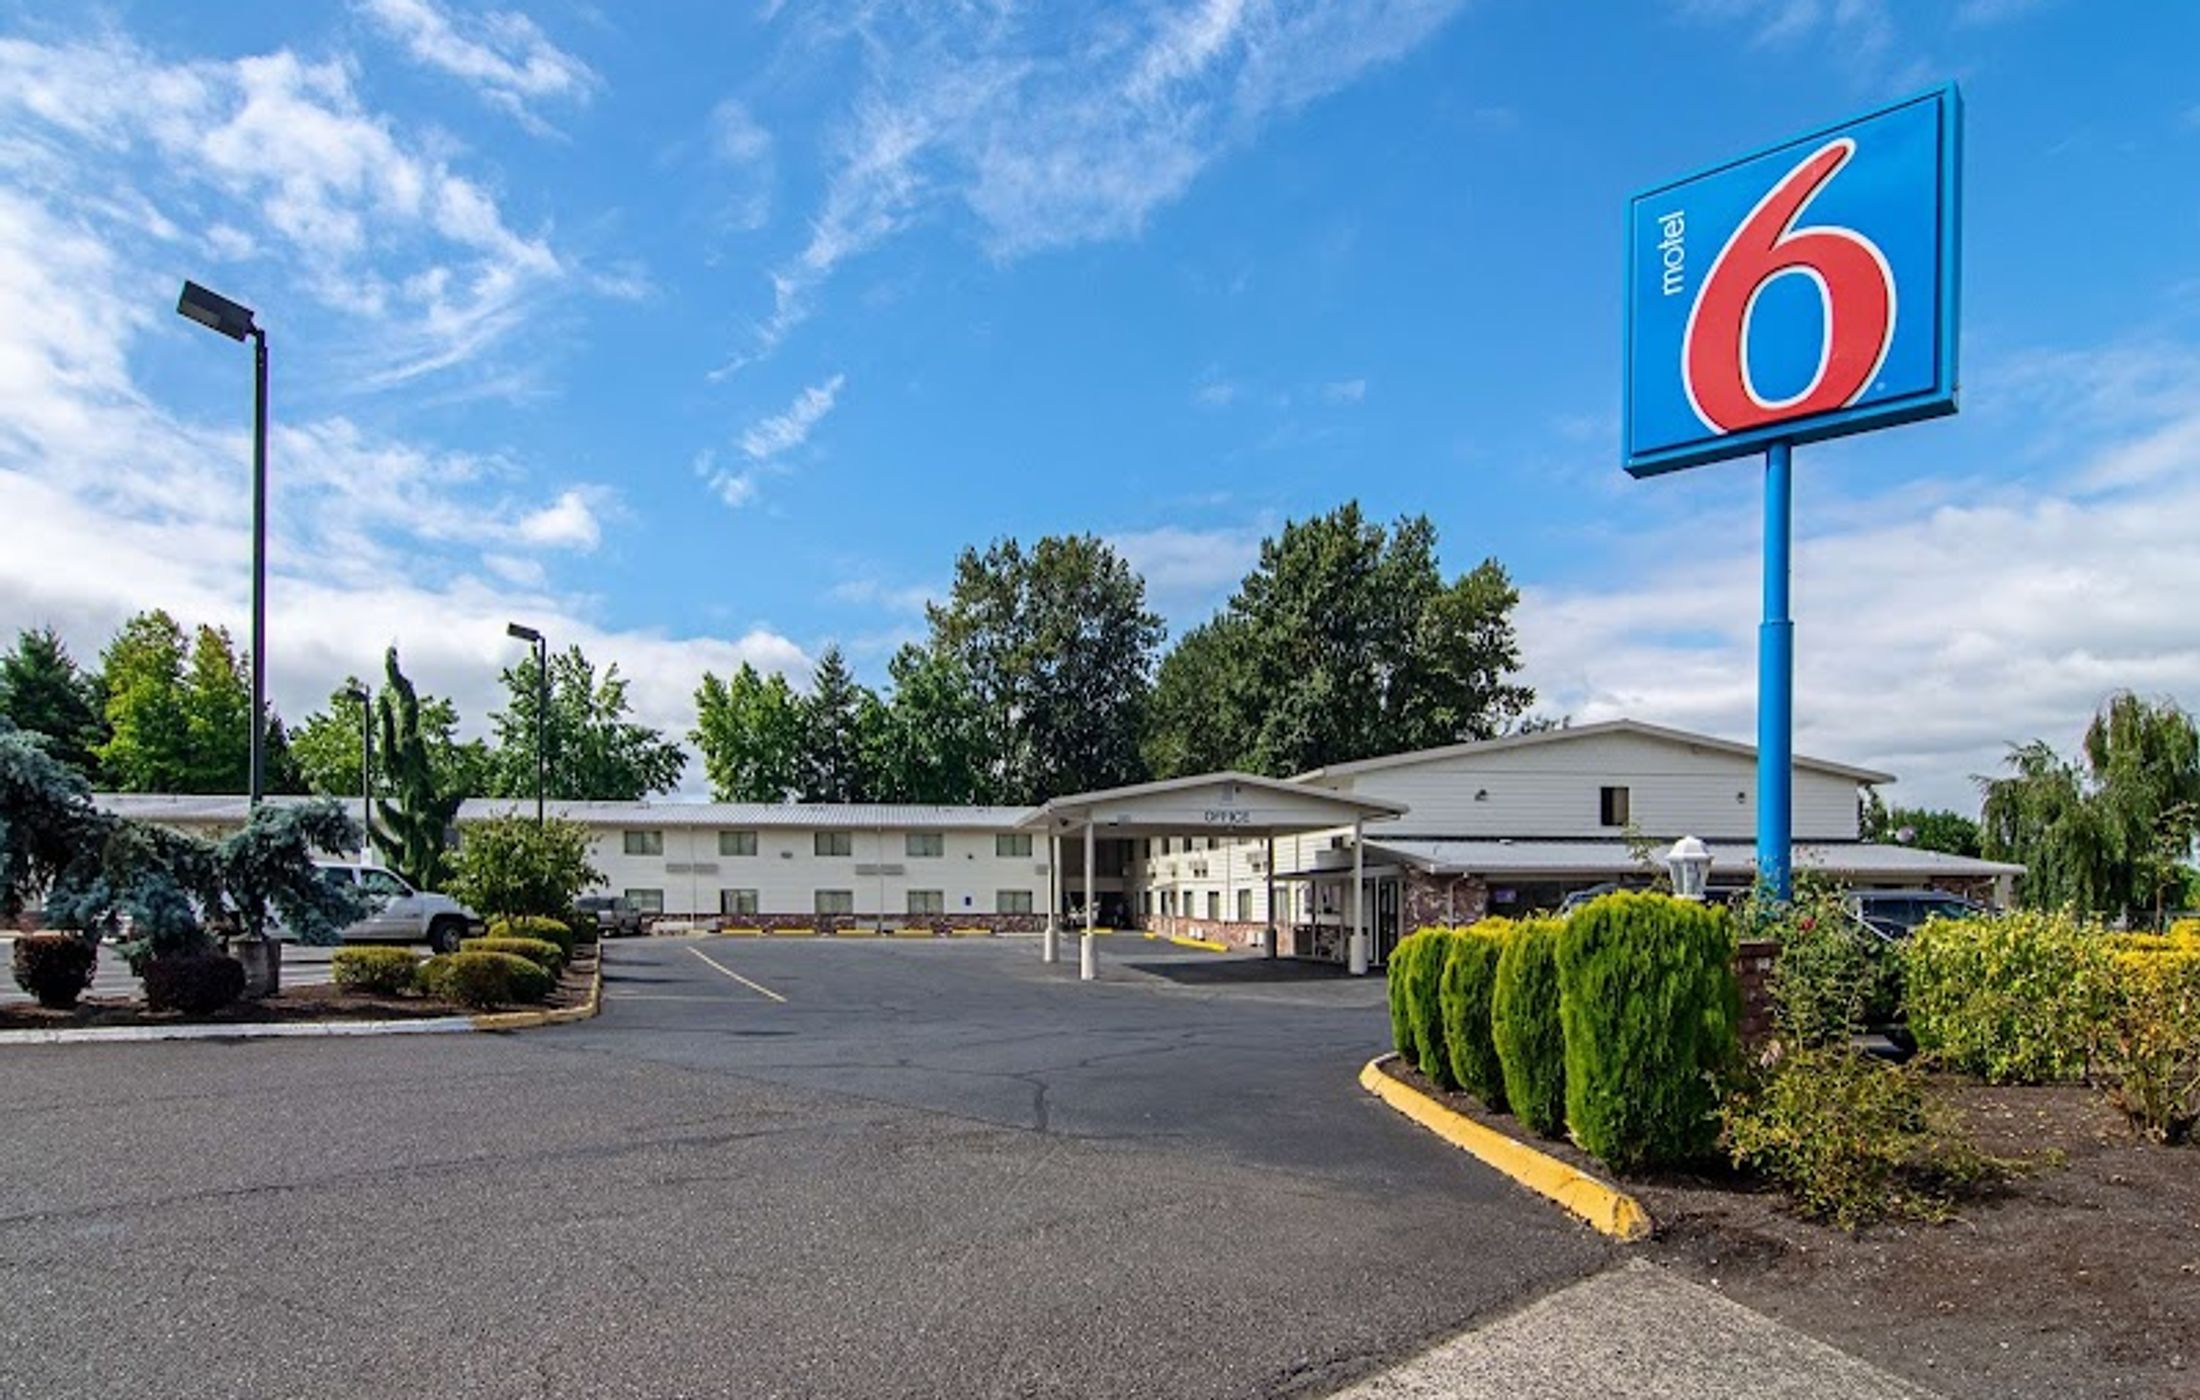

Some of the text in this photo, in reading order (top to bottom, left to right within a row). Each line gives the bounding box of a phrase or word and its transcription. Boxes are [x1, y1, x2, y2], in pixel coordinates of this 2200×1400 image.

[1657, 209, 1685, 296] motel
[1681, 137, 1897, 435] 6
[1204, 809, 1251, 823] OFFICE
